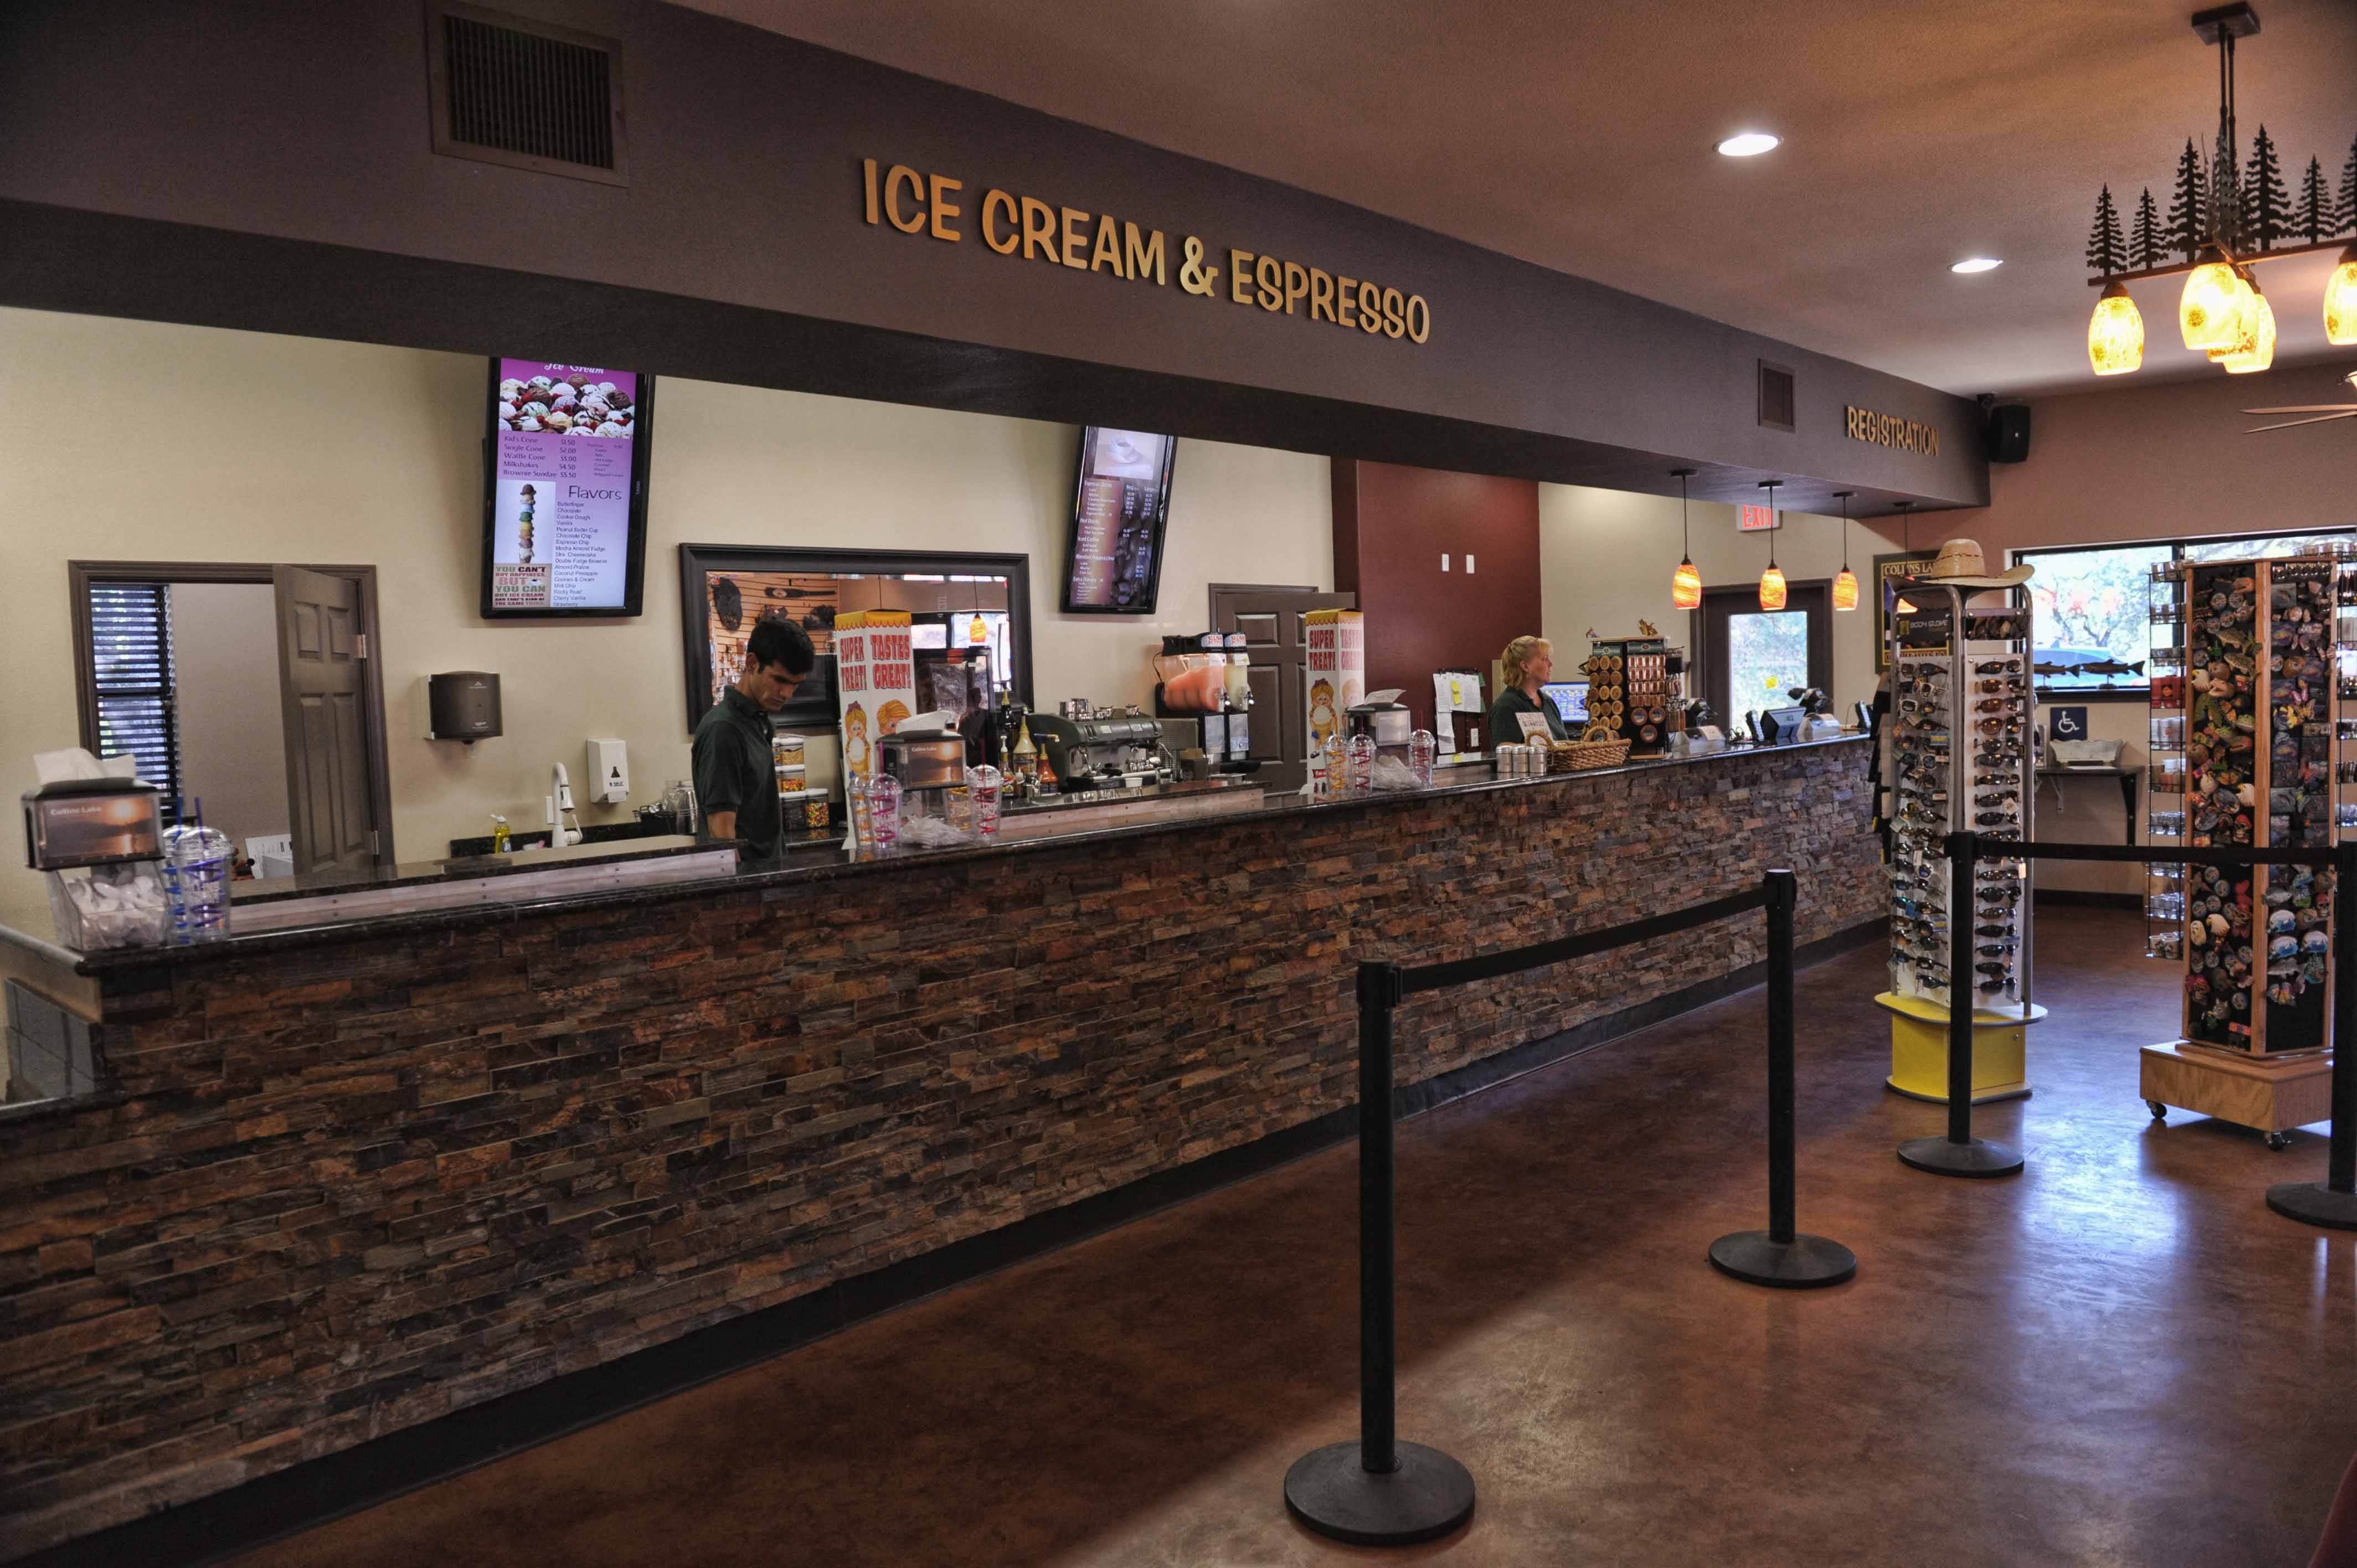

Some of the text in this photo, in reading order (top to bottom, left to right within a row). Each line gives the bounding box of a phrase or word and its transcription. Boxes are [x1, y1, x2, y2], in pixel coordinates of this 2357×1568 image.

[863, 158, 1430, 343] ICE CREAM & ESPRESSO
[1848, 405, 1940, 456] REGISTRATION
[569, 486, 622, 500] Flavors
[1743, 504, 1774, 527] EXIT
[499, 577, 527, 585] BUT
[1885, 564, 1920, 575] COLLNS
[840, 636, 865, 663] SUPER
[870, 634, 909, 661] TASTES
[1309, 629, 1335, 649] SUPER
[1309, 651, 1336, 672] TREAT!
[841, 664, 867, 692] TREAT!
[872, 663, 912, 689] GREAT!
